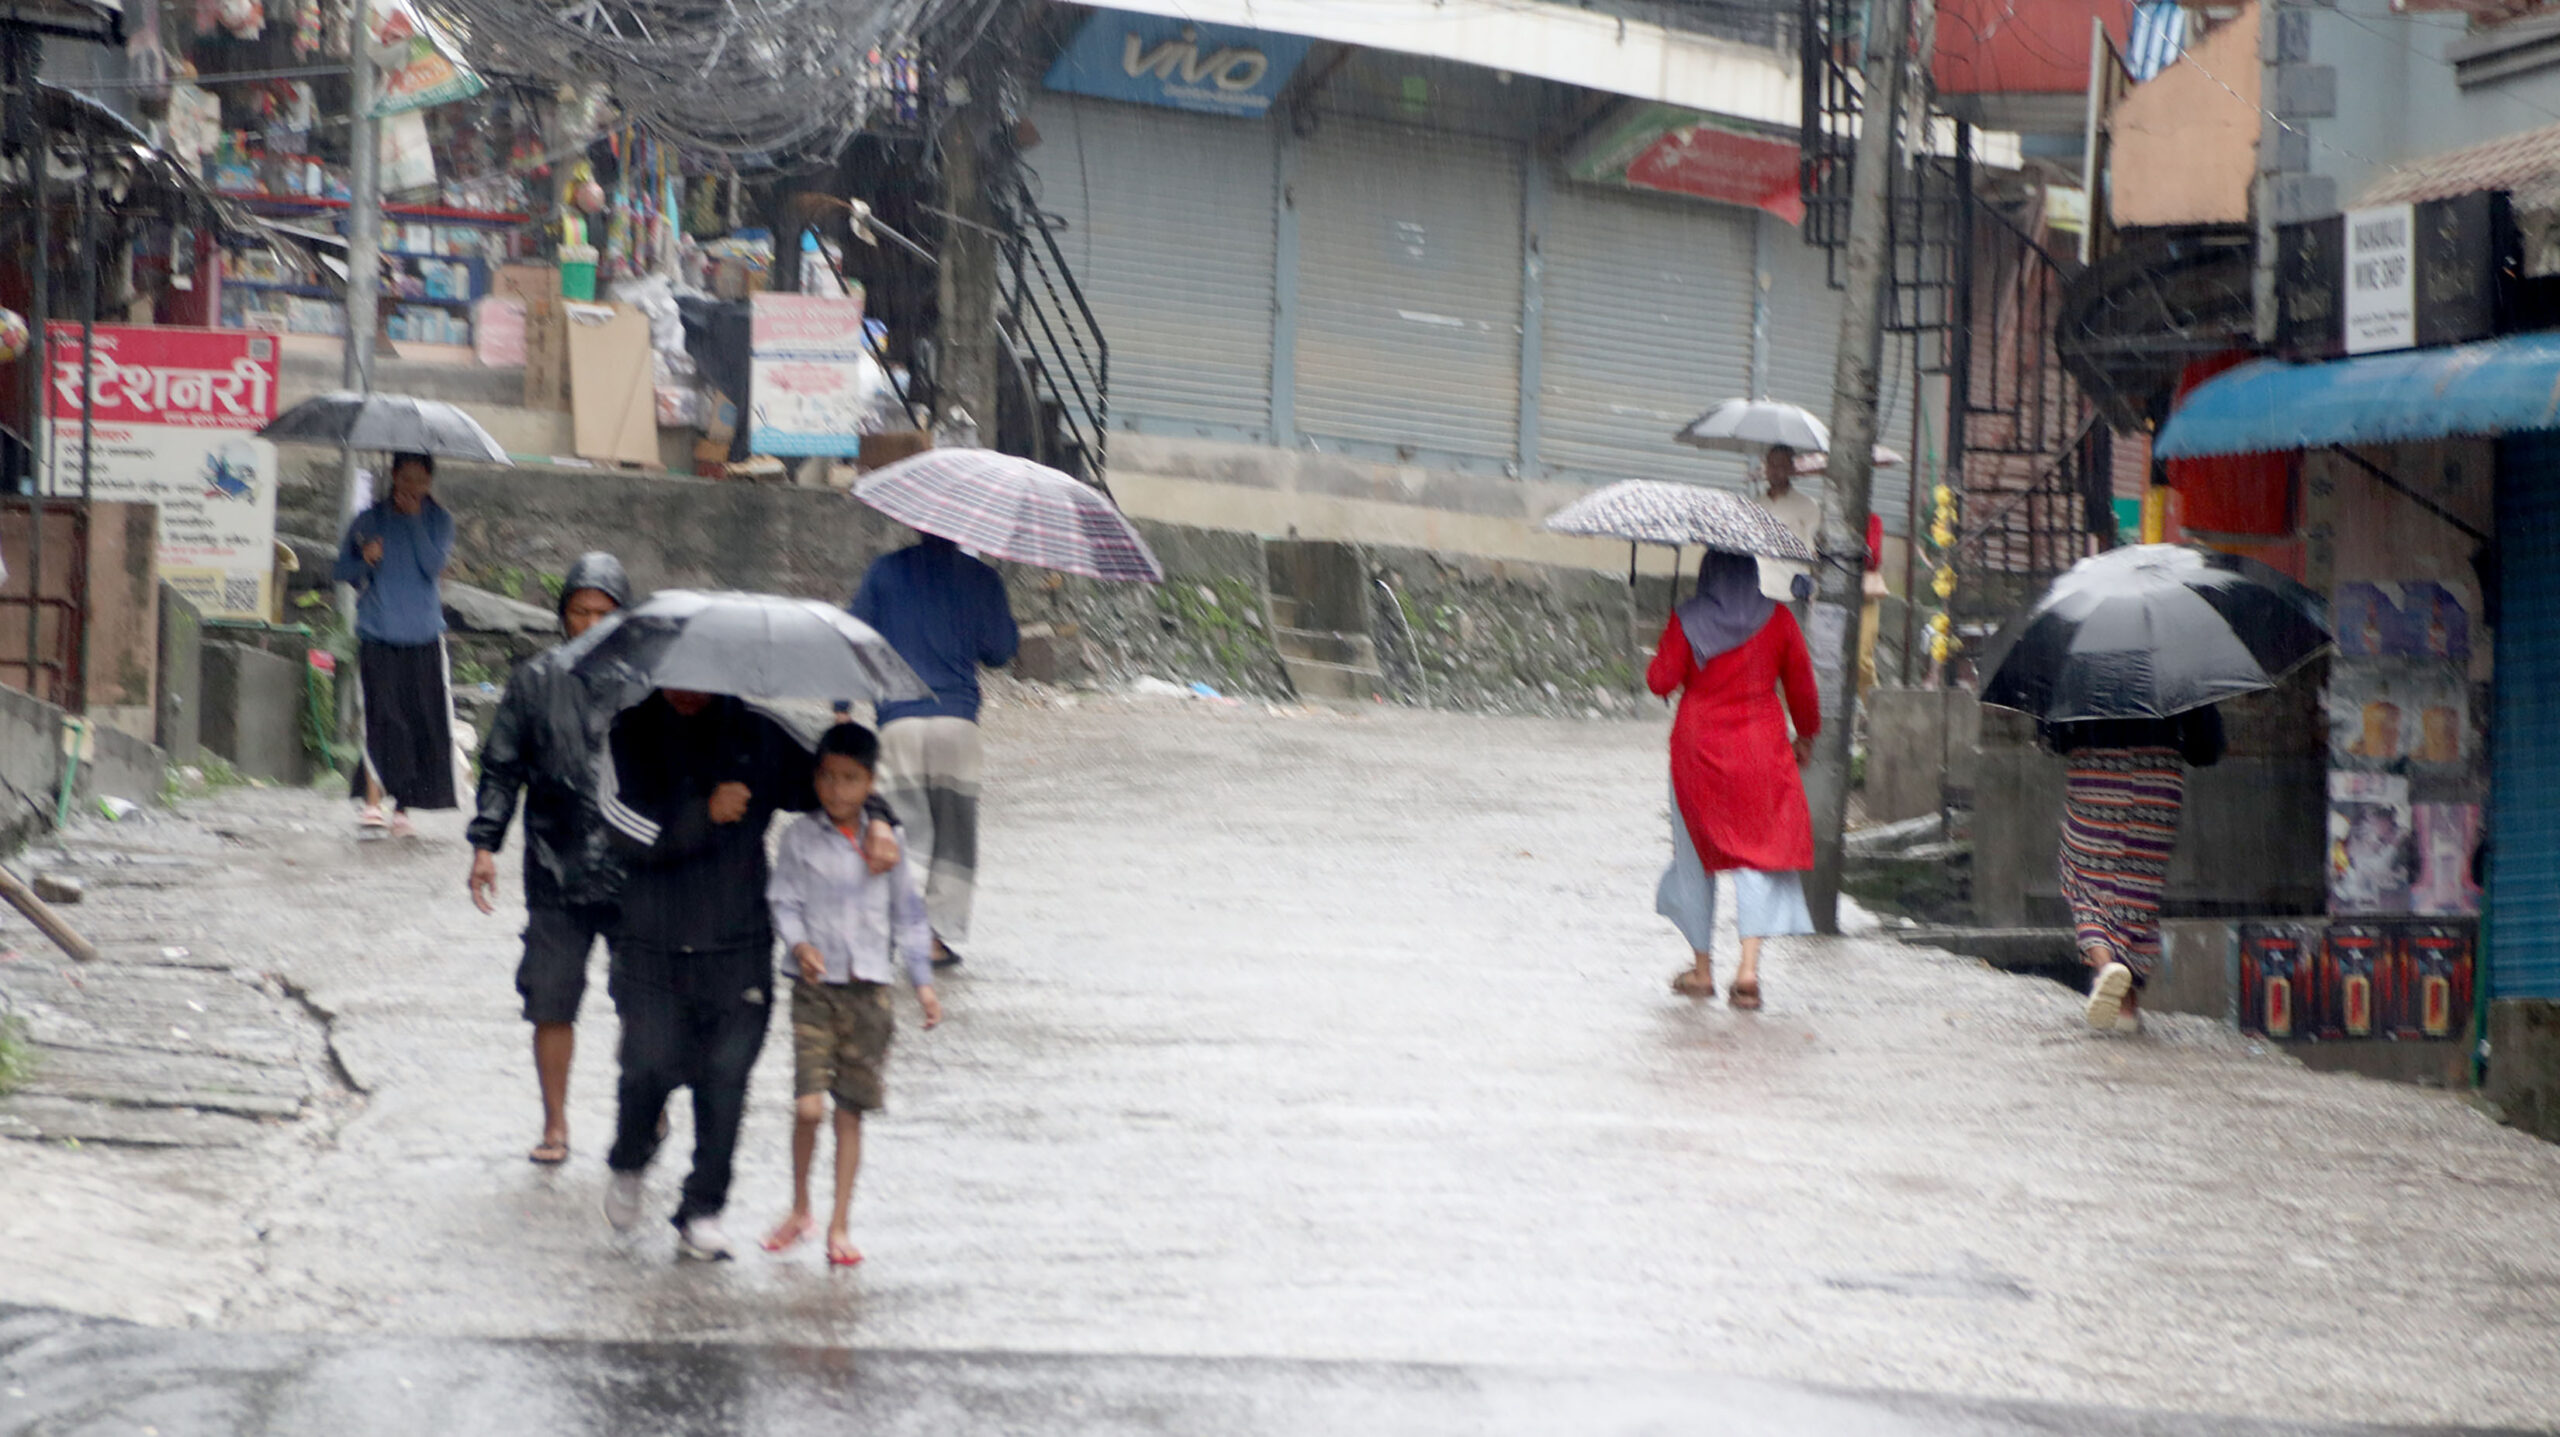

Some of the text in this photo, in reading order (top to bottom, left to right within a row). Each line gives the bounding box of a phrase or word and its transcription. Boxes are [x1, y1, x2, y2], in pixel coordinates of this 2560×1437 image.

[1122, 24, 1269, 91] vivo
[2381, 254, 2407, 289] SHOP
[52, 349, 273, 416] स्टेशनरी
